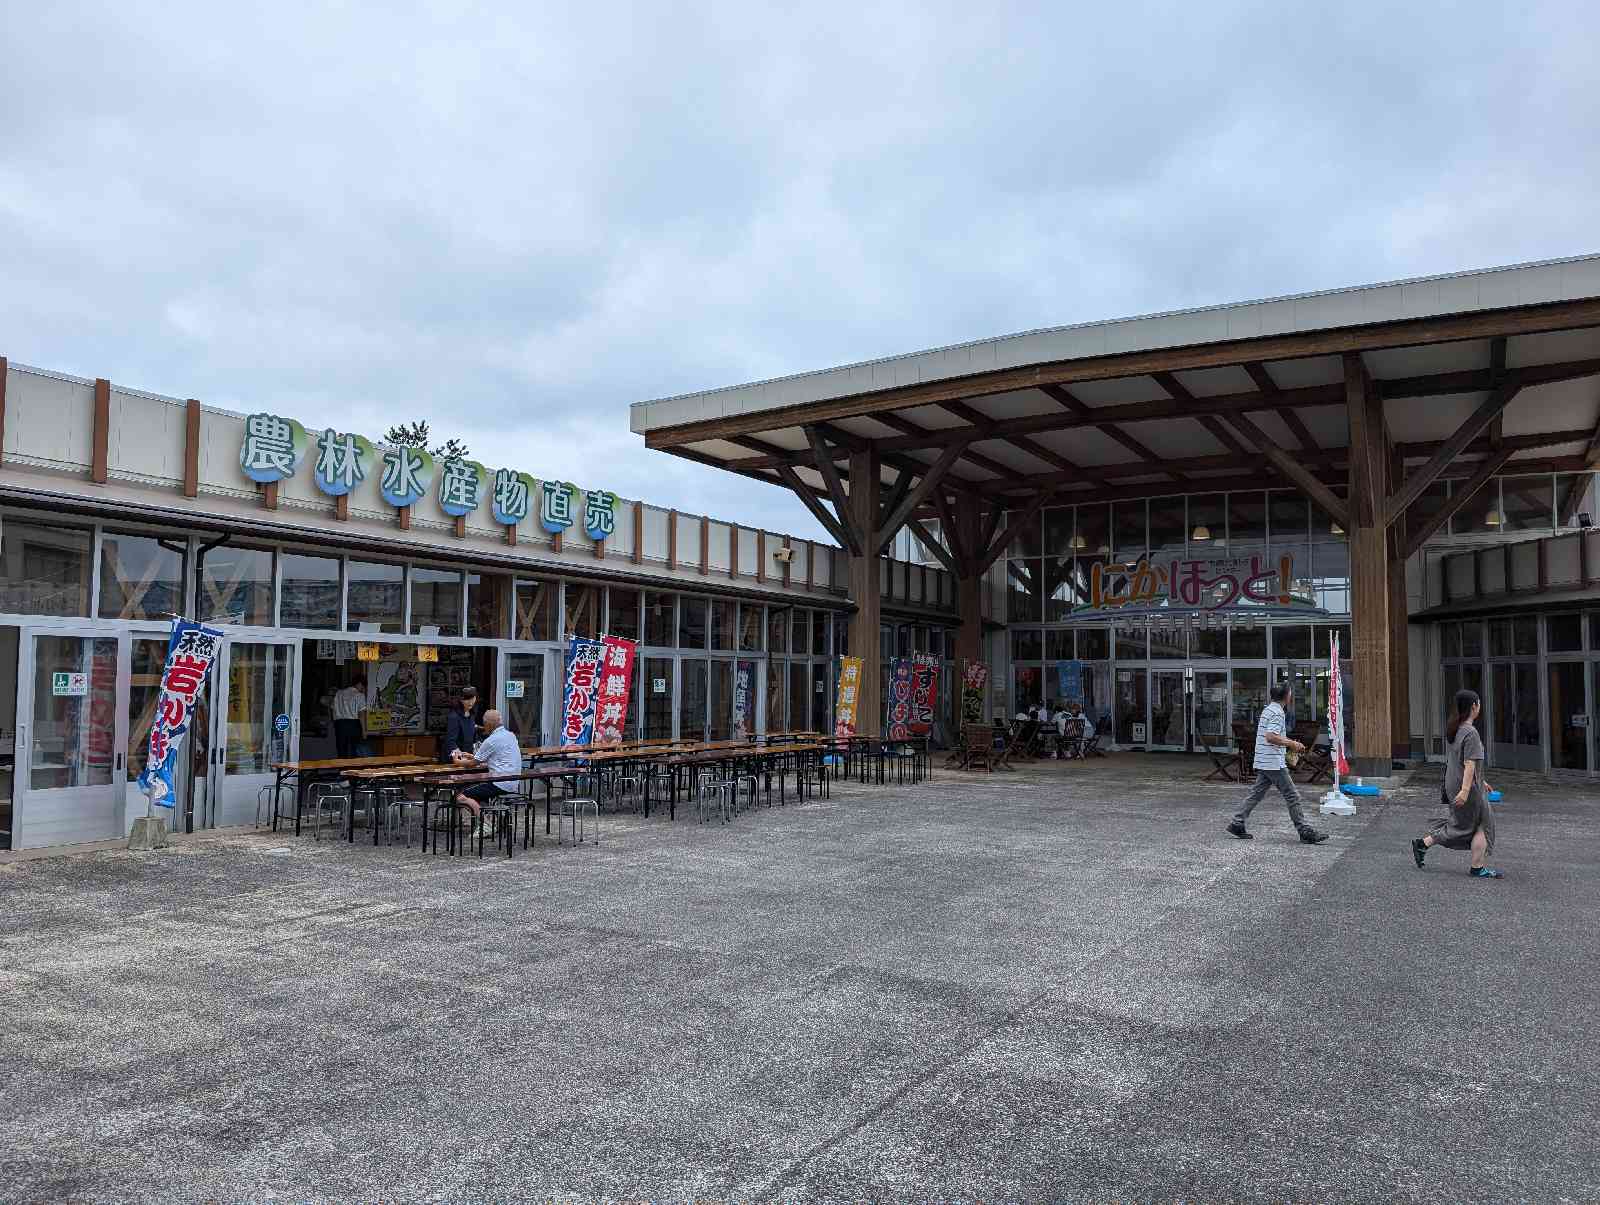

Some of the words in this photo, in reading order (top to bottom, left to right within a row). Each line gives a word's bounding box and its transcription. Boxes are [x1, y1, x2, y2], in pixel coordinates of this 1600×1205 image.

[240, 413, 616, 535] 農林水産物直売
